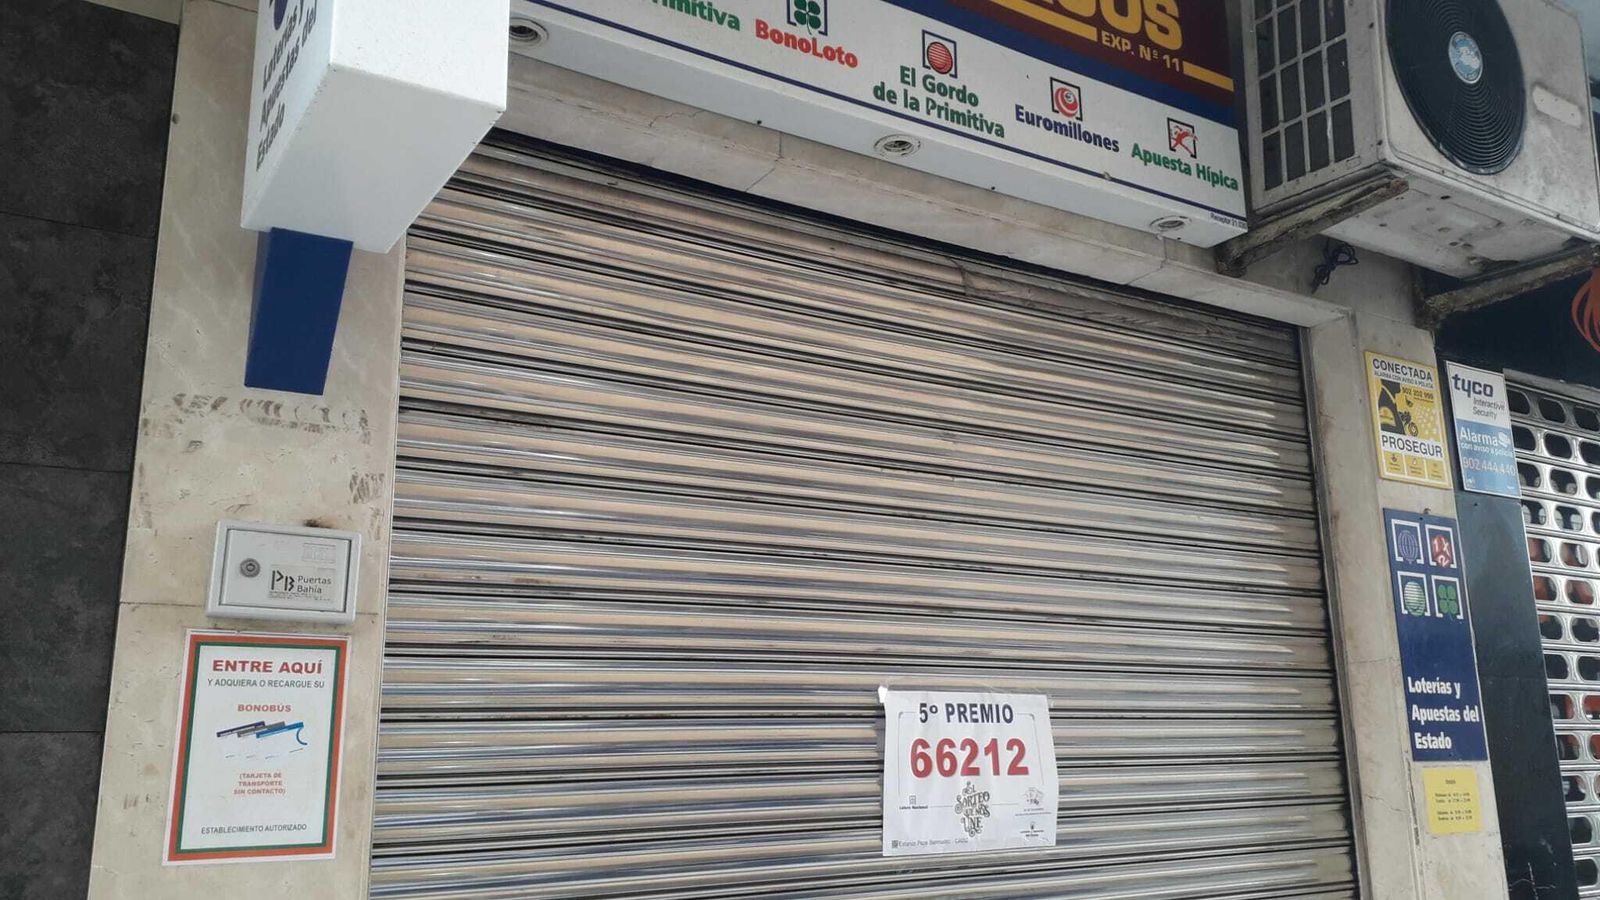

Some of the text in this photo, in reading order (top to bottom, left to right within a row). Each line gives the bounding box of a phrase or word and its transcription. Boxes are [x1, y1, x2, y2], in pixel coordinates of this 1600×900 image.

[651, 0, 740, 31] mitiva
[755, 19, 858, 68] BonoLoto
[1101, 30, 1134, 56] EXP.
[1163, 54, 1180, 72] 11
[260, 36, 300, 133] Apuestas
[900, 65, 979, 107] El Gordo
[873, 81, 1005, 138] de la Primitiva
[256, 103, 285, 172] Estado
[1015, 104, 1120, 152] Euromillones
[1131, 143, 1239, 191] Apuesta Hípica
[1372, 358, 1433, 383] CONECTADA
[1452, 374, 1494, 398] tyco
[1472, 406, 1498, 420] Security
[1473, 397, 1505, 411] Interactive
[1382, 434, 1443, 459] PROSEGUR
[1460, 426, 1498, 446] Alarma
[1461, 441, 1472, 450] con
[1462, 456, 1480, 471] 902
[297, 576, 332, 585] Puertas
[297, 585, 322, 594] Bahía
[212, 660, 323, 674] ENTRE AQUÍ
[207, 679, 213, 687] Y
[214, 679, 257, 688] ADQUIERA
[268, 680, 311, 688] RECARGUE
[313, 681, 325, 689] SU
[1407, 676, 1460, 699] Loterías y
[237, 704, 291, 713] BONOBÚS
[919, 703, 1014, 724] 5º PREMIO
[1411, 704, 1479, 725] Apuestas del
[1414, 731, 1452, 750] Estado
[910, 738, 1029, 779] 66212
[201, 823, 308, 835] ESTABLECIMIENTO AUTORIZADO
